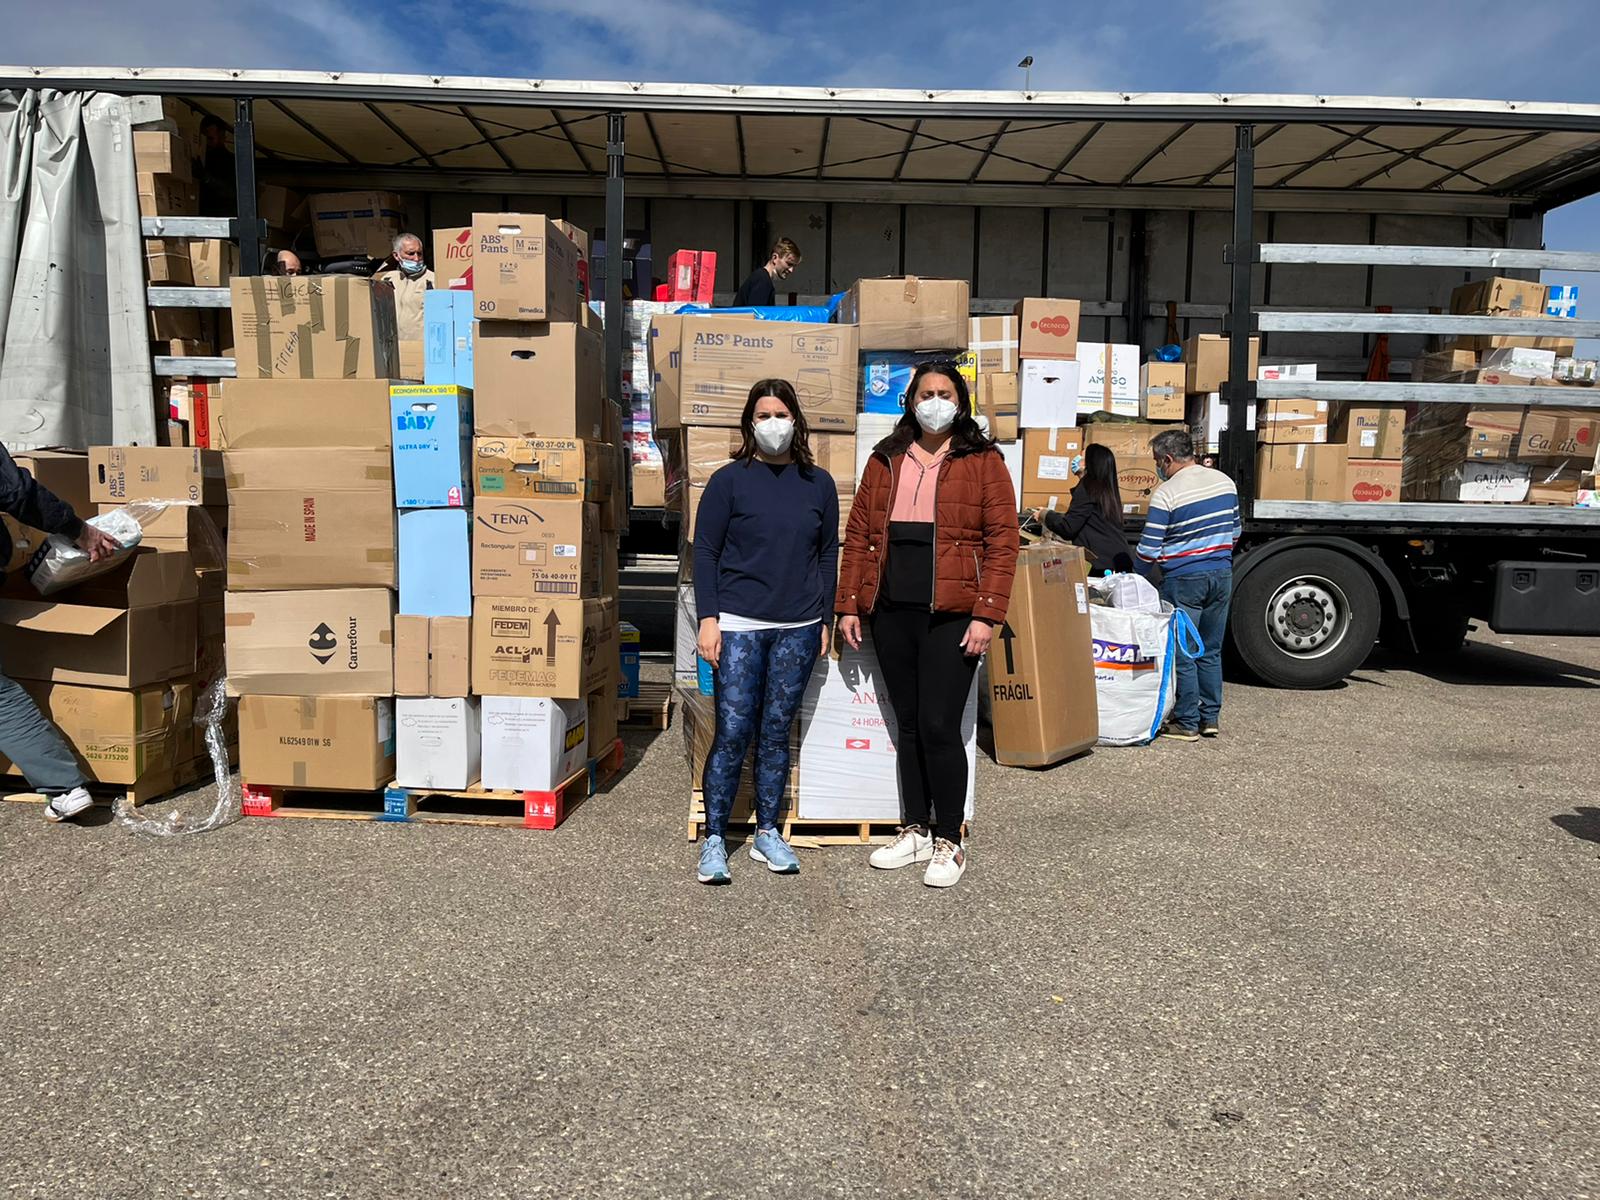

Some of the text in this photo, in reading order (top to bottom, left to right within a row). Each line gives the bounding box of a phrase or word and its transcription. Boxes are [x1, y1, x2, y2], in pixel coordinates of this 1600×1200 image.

[480, 244, 509, 253] Pants
[515, 239, 525, 248] M
[446, 243, 473, 259] Inco
[479, 300, 496, 312] 80
[732, 334, 774, 349] Pants
[796, 337, 806, 348] G
[1088, 376, 1127, 386] AMGO
[692, 403, 710, 414] 80
[397, 415, 436, 431] BABY
[478, 446, 505, 454] TENA
[545, 441, 565, 449] 37-02
[117, 471, 126, 497] Pants
[188, 485, 199, 501] 60
[448, 486, 459, 499] 4
[303, 497, 315, 516] SPAIN
[490, 513, 529, 525] TENA
[304, 524, 317, 542] MADE
[491, 605, 527, 613] MIEMBRO
[494, 620, 528, 630] FEDEM
[347, 616, 359, 670] Carrefour
[489, 669, 557, 682] FEDEMAC
[993, 680, 1034, 702] FRÁGIL
[851, 718, 861, 726] 24
